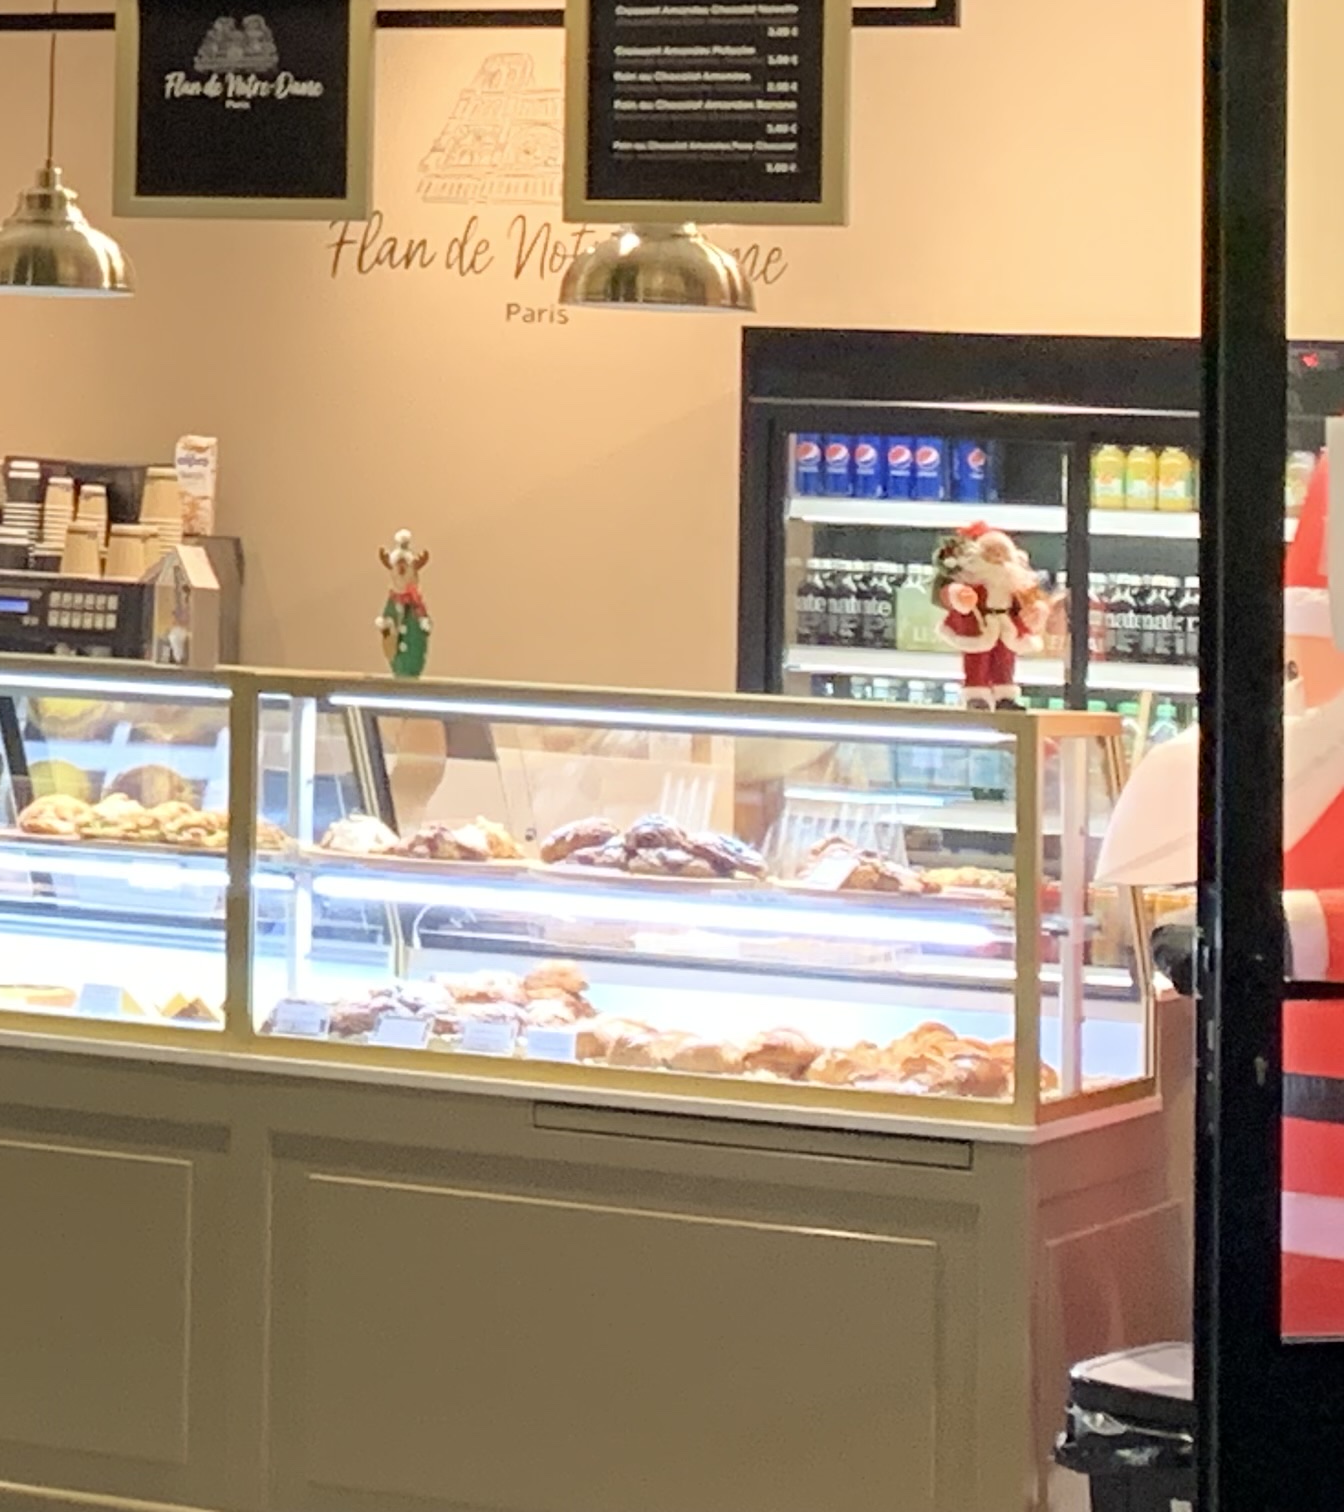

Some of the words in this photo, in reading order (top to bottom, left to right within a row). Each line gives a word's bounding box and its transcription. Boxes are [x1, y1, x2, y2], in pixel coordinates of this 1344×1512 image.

[326, 209, 439, 279] Flan
[444, 214, 494, 278] de
[505, 302, 570, 325] Paris
